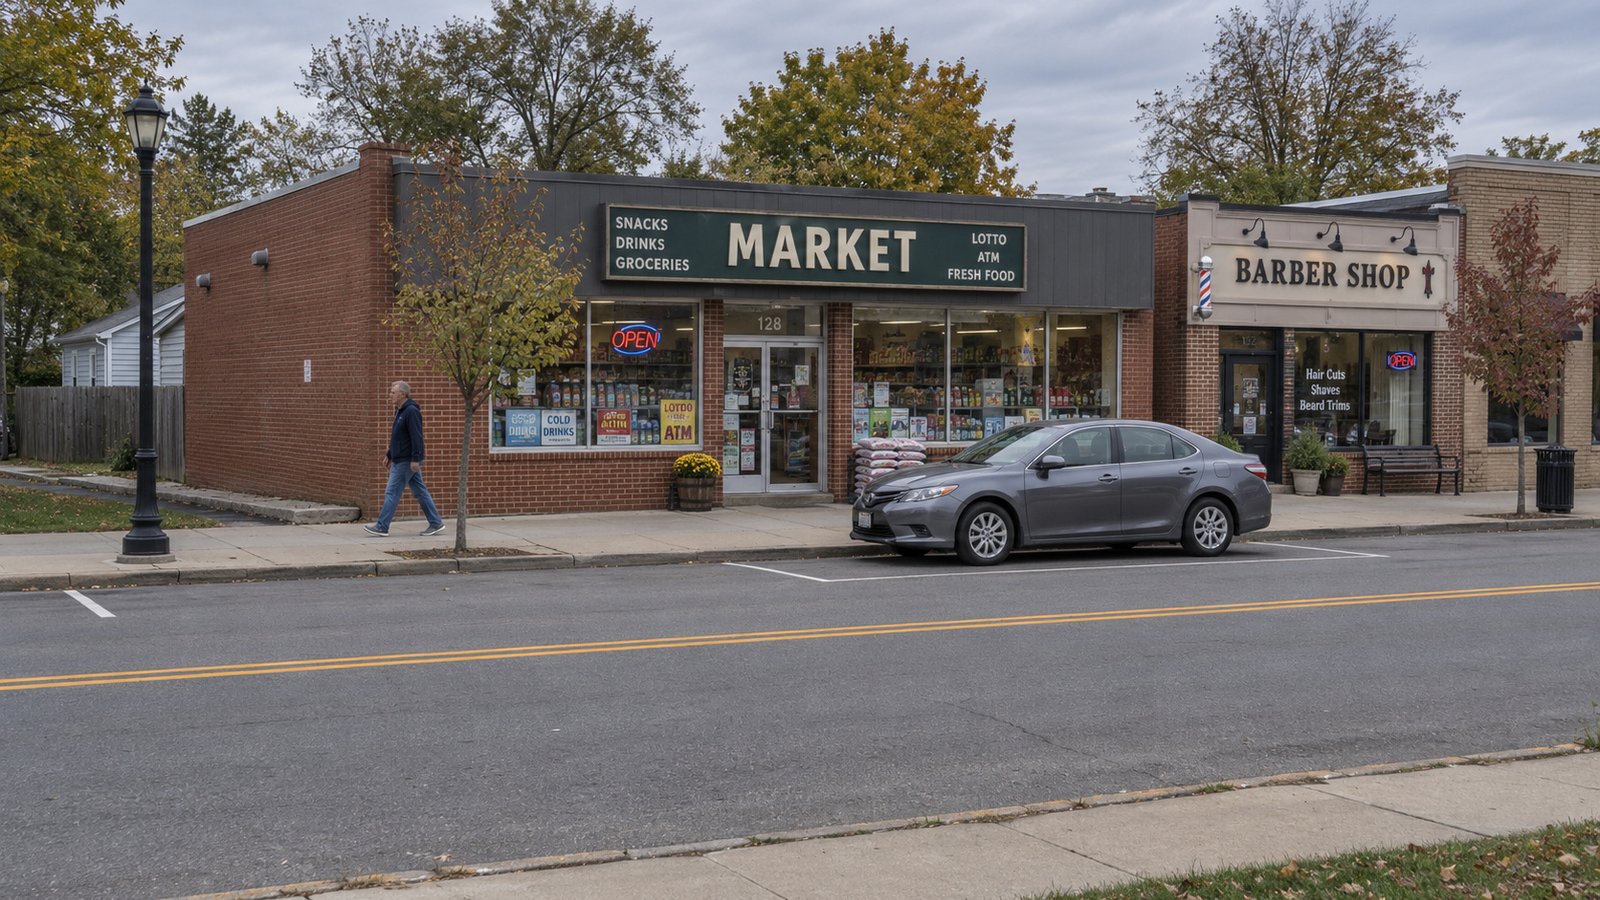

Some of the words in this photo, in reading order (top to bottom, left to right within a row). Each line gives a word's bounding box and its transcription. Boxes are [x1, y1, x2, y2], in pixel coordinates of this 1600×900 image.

[615, 216, 668, 232] SNACKS
[615, 236, 666, 251] DRINKS
[972, 232, 1007, 246] LOTTO
[727, 222, 918, 274] MARKET
[615, 256, 690, 272] GROCERIES
[977, 251, 1000, 263] ATM
[948, 268, 982, 280] FRESH
[985, 269, 1015, 282] FOOD
[1235, 257, 1338, 287] BARBER
[1347, 262, 1410, 289] SHOP
[758, 316, 782, 331] 128
[612, 330, 659, 349] OPEN
[1389, 354, 1414, 367] OPEN
[1305, 368, 1325, 380] Hair
[1326, 368, 1346, 380] Cuts
[1311, 384, 1341, 396] Shaves
[1299, 399, 1325, 411] Beard
[1326, 399, 1351, 411] Trims
[547, 415, 571, 424] COLD
[543, 427, 575, 436] DRINKS
[664, 425, 692, 441] ATM
